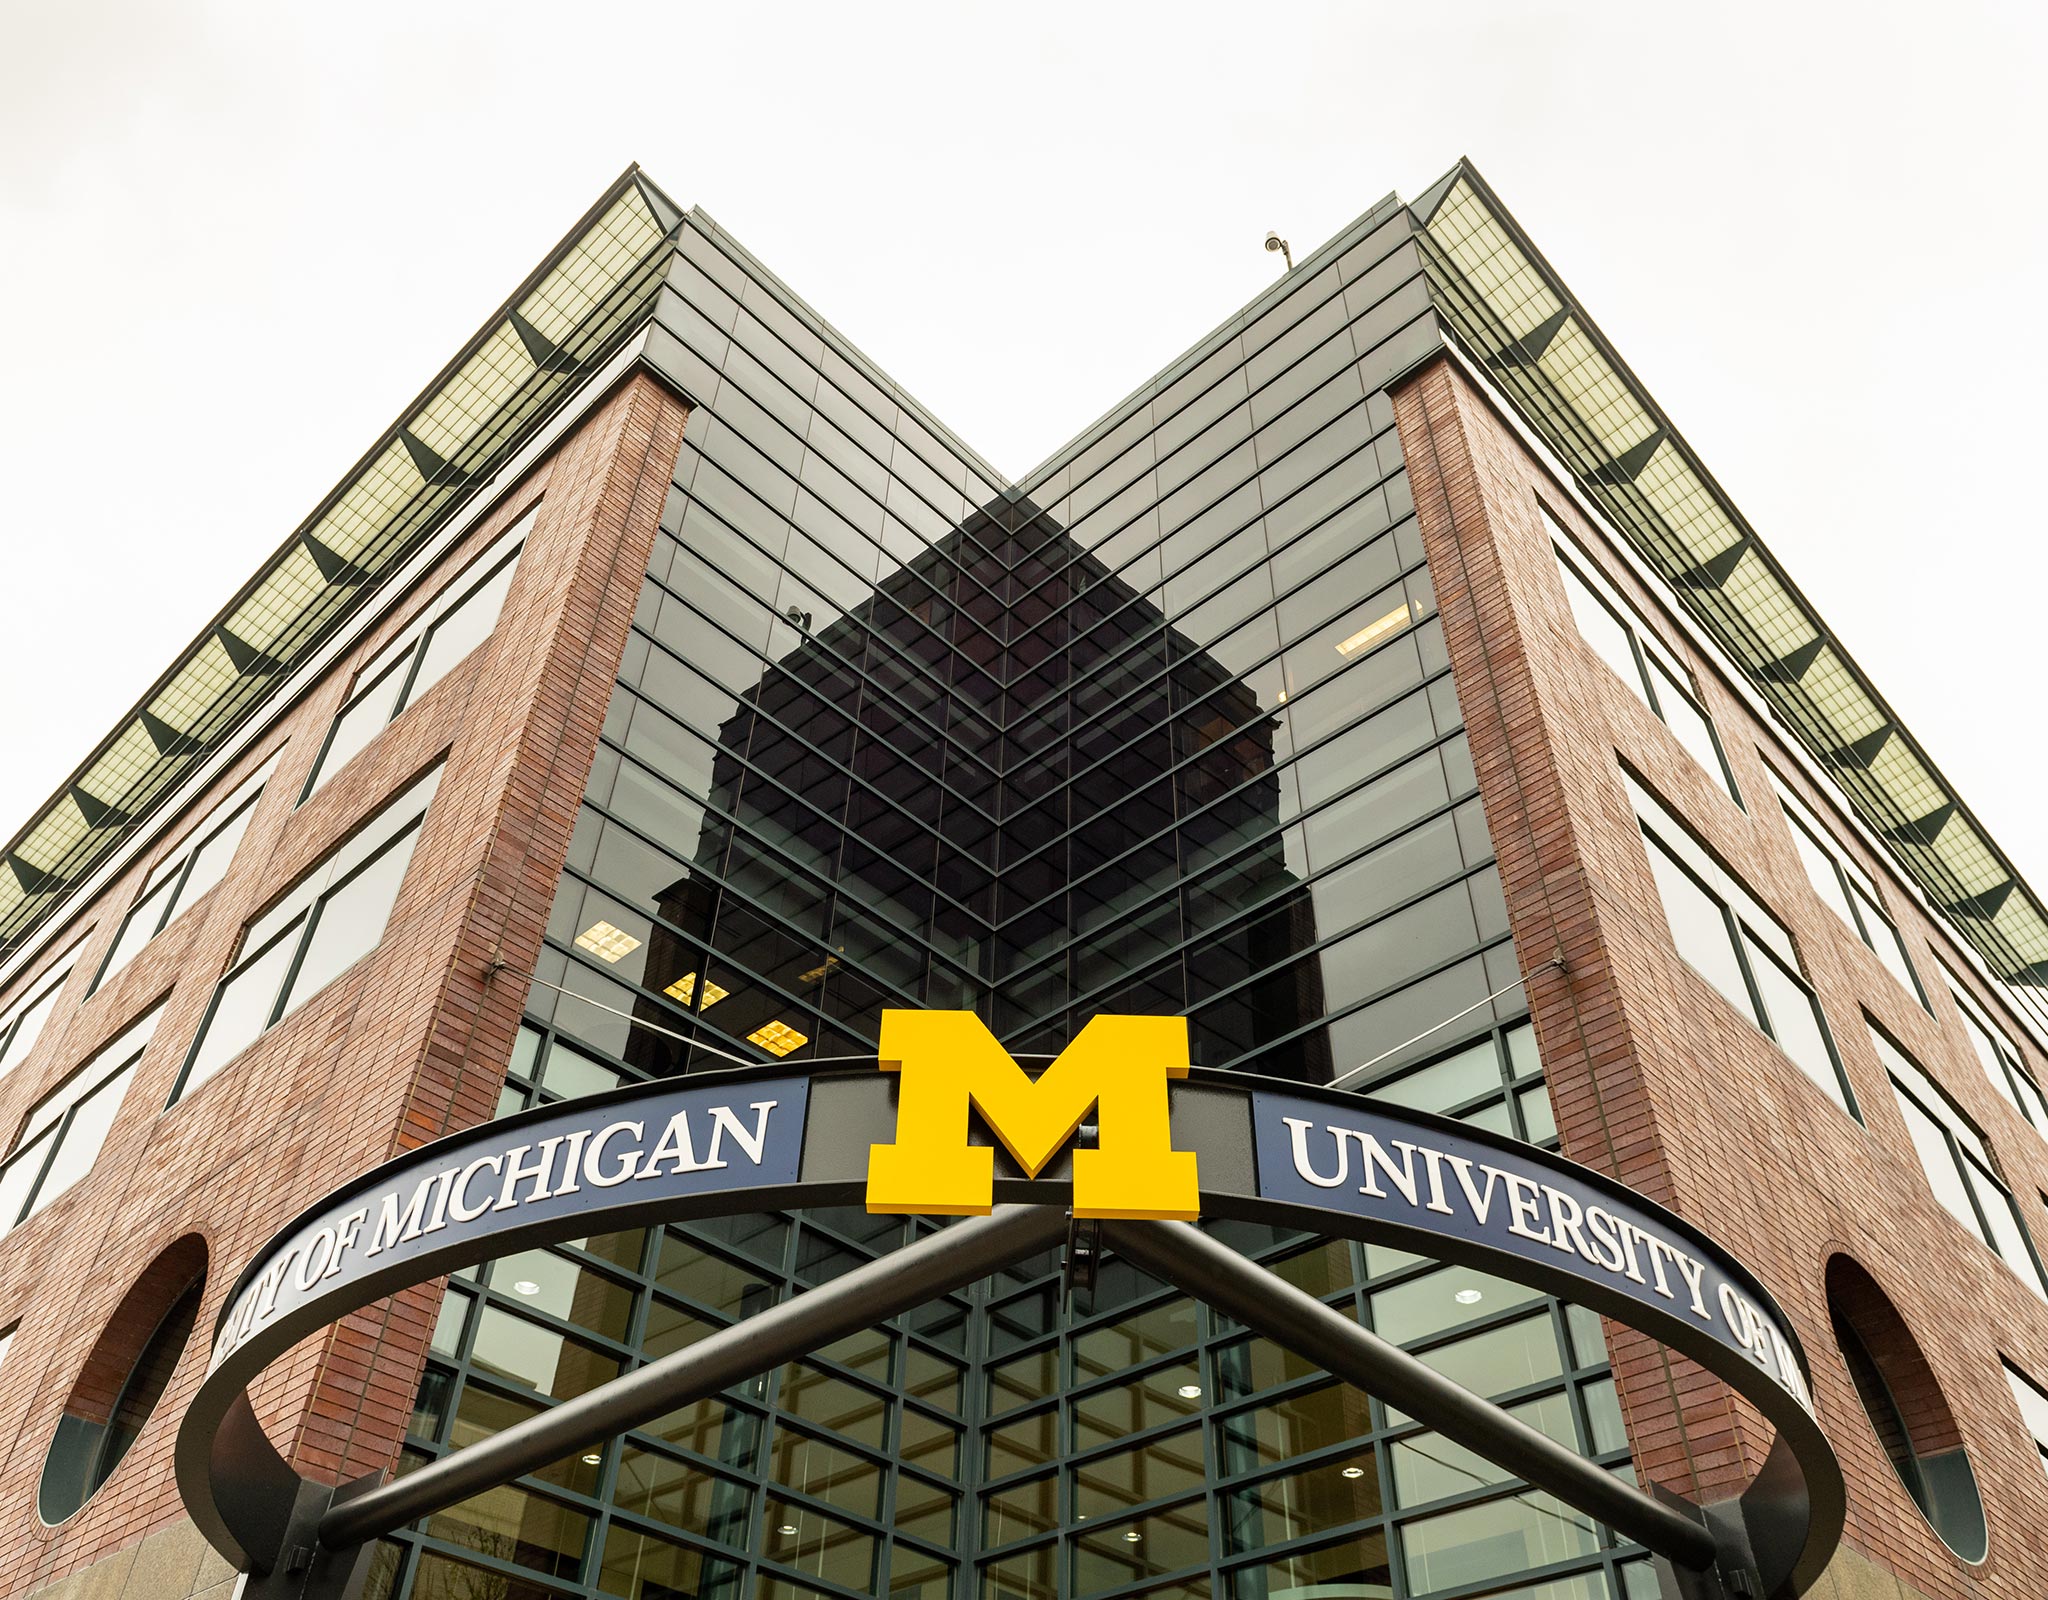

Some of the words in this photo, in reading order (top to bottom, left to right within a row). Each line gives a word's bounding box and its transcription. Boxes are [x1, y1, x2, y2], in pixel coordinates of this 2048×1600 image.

[295, 1207, 369, 1292] OF
[364, 1100, 778, 1258] MICHIGAN
[866, 1008, 1200, 1221] M
[1281, 1116, 1712, 1321] UNIVERSITY
[1717, 1282, 1769, 1365] OF
